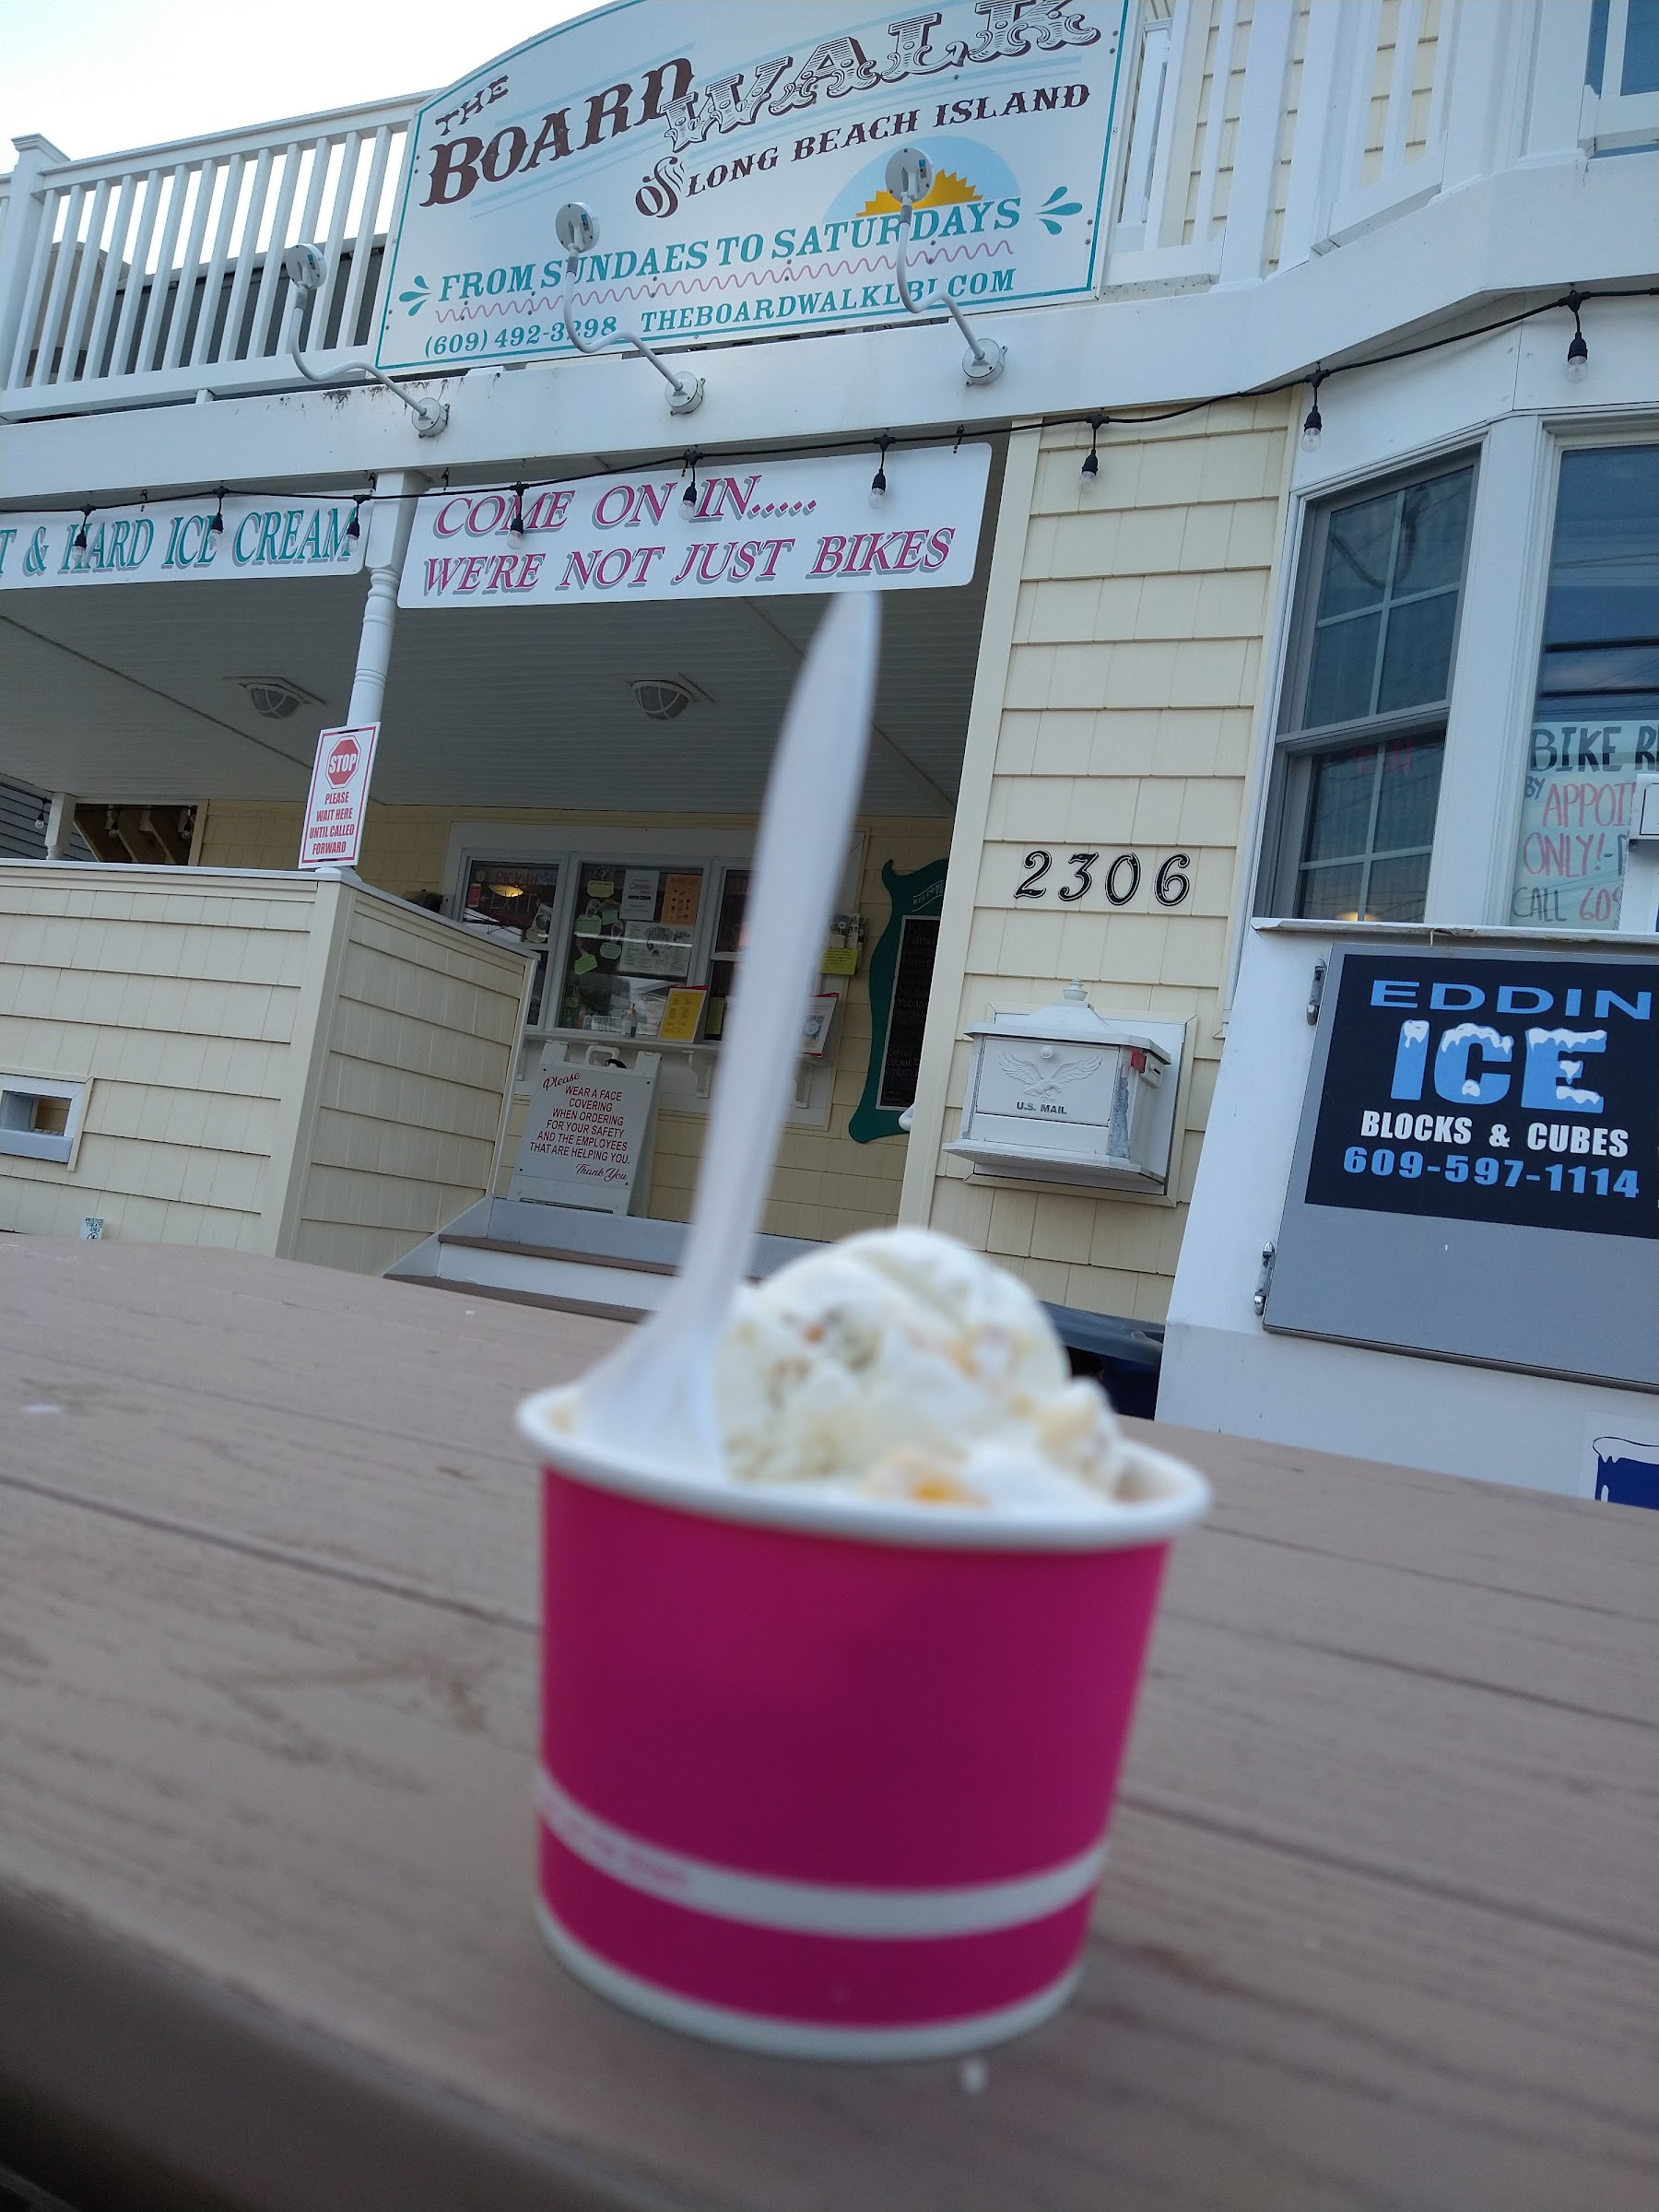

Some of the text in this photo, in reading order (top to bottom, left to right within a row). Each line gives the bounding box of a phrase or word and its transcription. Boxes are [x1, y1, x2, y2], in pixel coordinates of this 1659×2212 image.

[658, 0, 1100, 152] WALK
[435, 75, 509, 135] THE
[419, 57, 695, 207] BOARD
[686, 147, 780, 197] LONG
[793, 110, 919, 162] BEACH
[935, 83, 1090, 127] ISLAND
[438, 264, 535, 302] FROM
[715, 233, 763, 266] TO
[771, 196, 1022, 260] SATURDAYS
[425, 328, 488, 358] (609)
[641, 267, 1017, 333] THEBOARDWALKLBICOM
[435, 488, 575, 537] COME
[593, 482, 677, 528] ON
[24, 526, 49, 575] &
[60, 518, 154, 572] HARD
[163, 514, 218, 569] ICE
[234, 507, 358, 565] CREAM
[425, 527, 956, 595] WE'RE NOT JUST BIKES
[329, 753, 358, 773] STOP
[1530, 724, 1659, 772] BIKE R
[316, 807, 353, 822] WAIT HERE
[324, 792, 349, 805] PLEASE
[1524, 776, 1636, 828] BY APPOI
[310, 823, 355, 839] UNTIL CALLED
[312, 841, 347, 855] FORWARD
[1014, 849, 1191, 906] 2306
[1512, 887, 1567, 922] CALL
[542, 1072, 581, 1091] Please
[1390, 1019, 1607, 1113] ICE
[565, 1085, 623, 1101] WEAR A FACE
[569, 1098, 613, 1112] COVERING
[1016, 1100, 1068, 1115] U.S. MAIL
[546, 1119, 625, 1138] FOR YOUR SAFETY
[552, 1108, 624, 1126] WHEN ORDERING
[1360, 1110, 1629, 1158] BLOCKS & CUBES
[530, 1141, 630, 1164] THAT ARE HELPING YOU.
[536, 1130, 628, 1151] AND THE EMPLOYEES
[575, 1163, 628, 1182] Thank You
[1343, 1146, 1640, 1198] 609-597-1114
